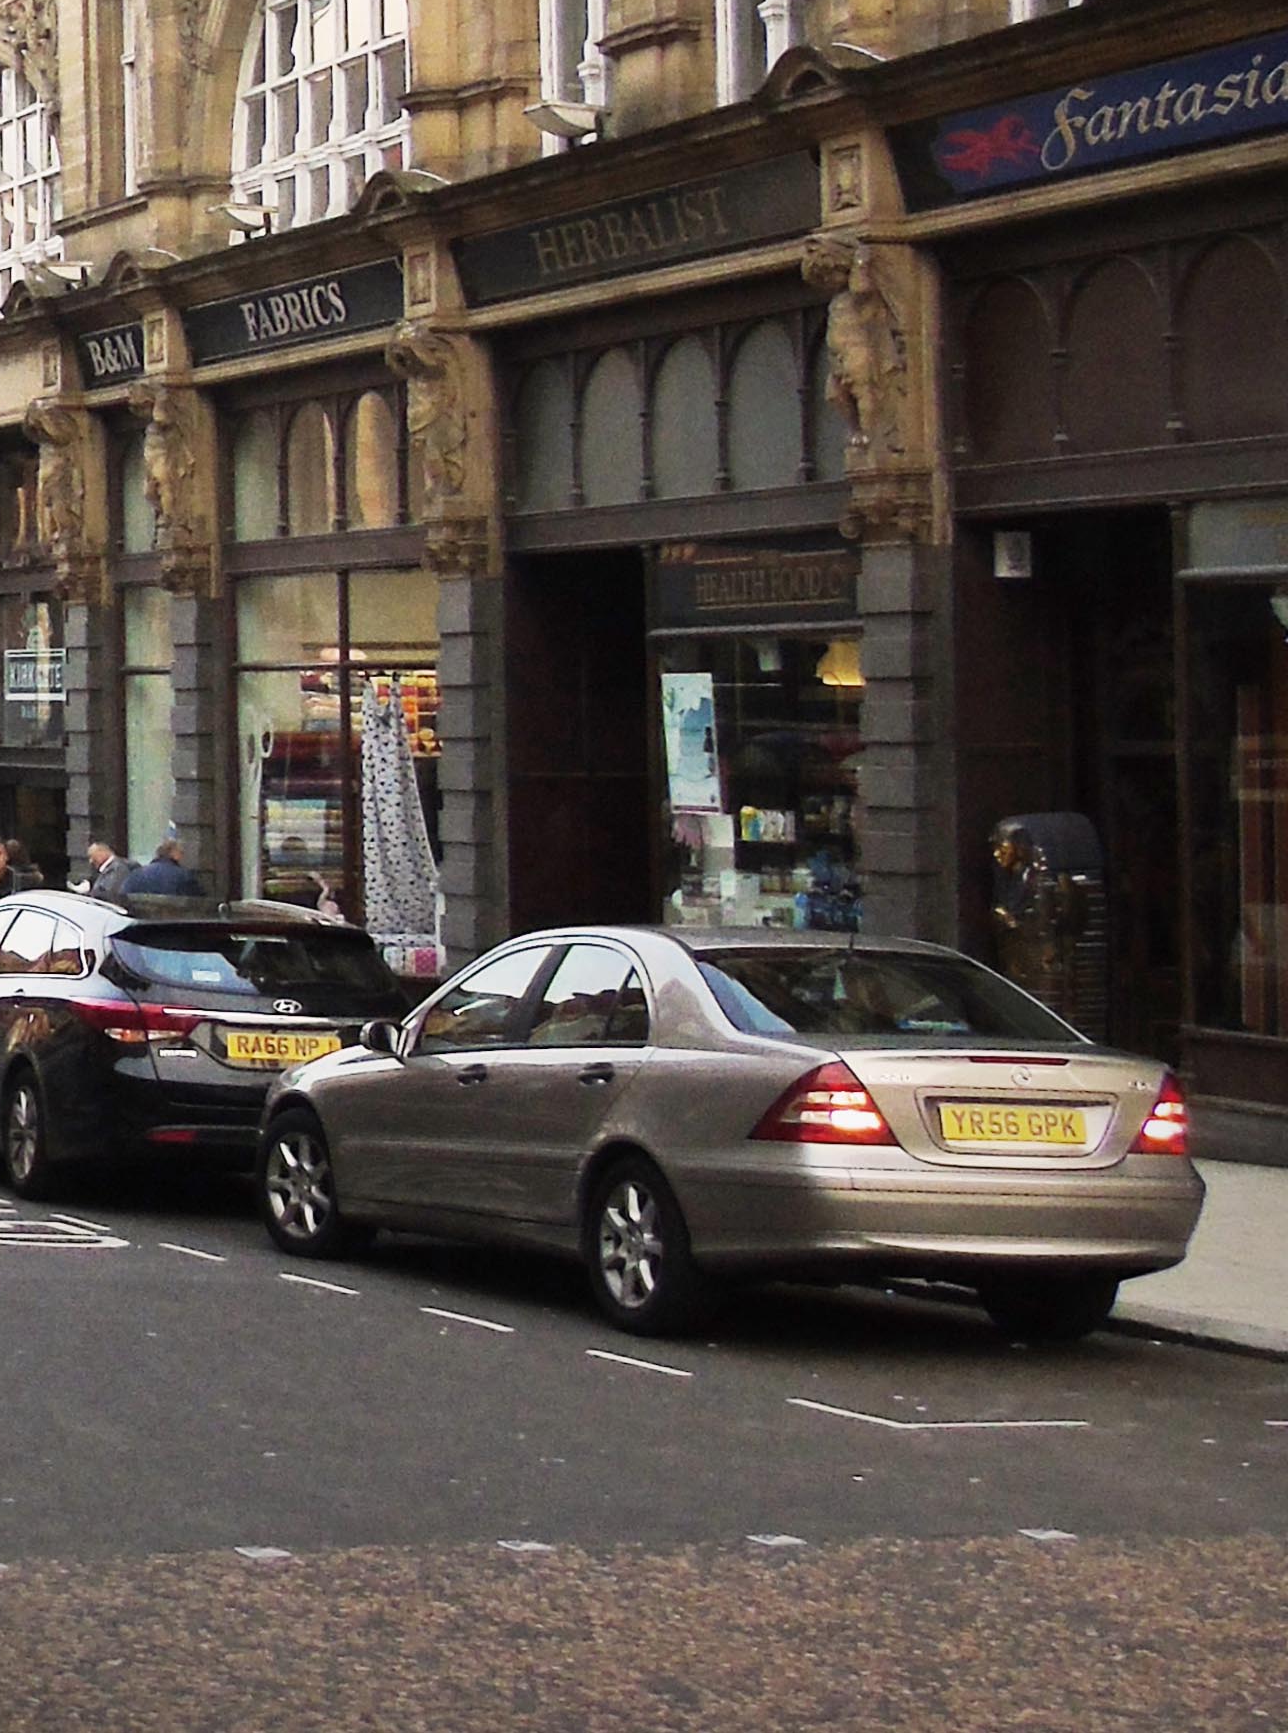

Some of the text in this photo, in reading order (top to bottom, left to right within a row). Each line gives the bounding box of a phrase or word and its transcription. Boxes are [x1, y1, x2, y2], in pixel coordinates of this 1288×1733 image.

[1041, 54, 1288, 170] Fantasia
[529, 187, 728, 274] HERBALIST
[239, 281, 346, 343] FABRICS
[87, 331, 140, 377] B&M
[695, 569, 765, 603] HEALTH
[770, 566, 821, 600] FOOD
[7, 662, 62, 688] KIRKTE
[237, 1035, 288, 1056] RA66
[1028, 1112, 1076, 1137] GPK
